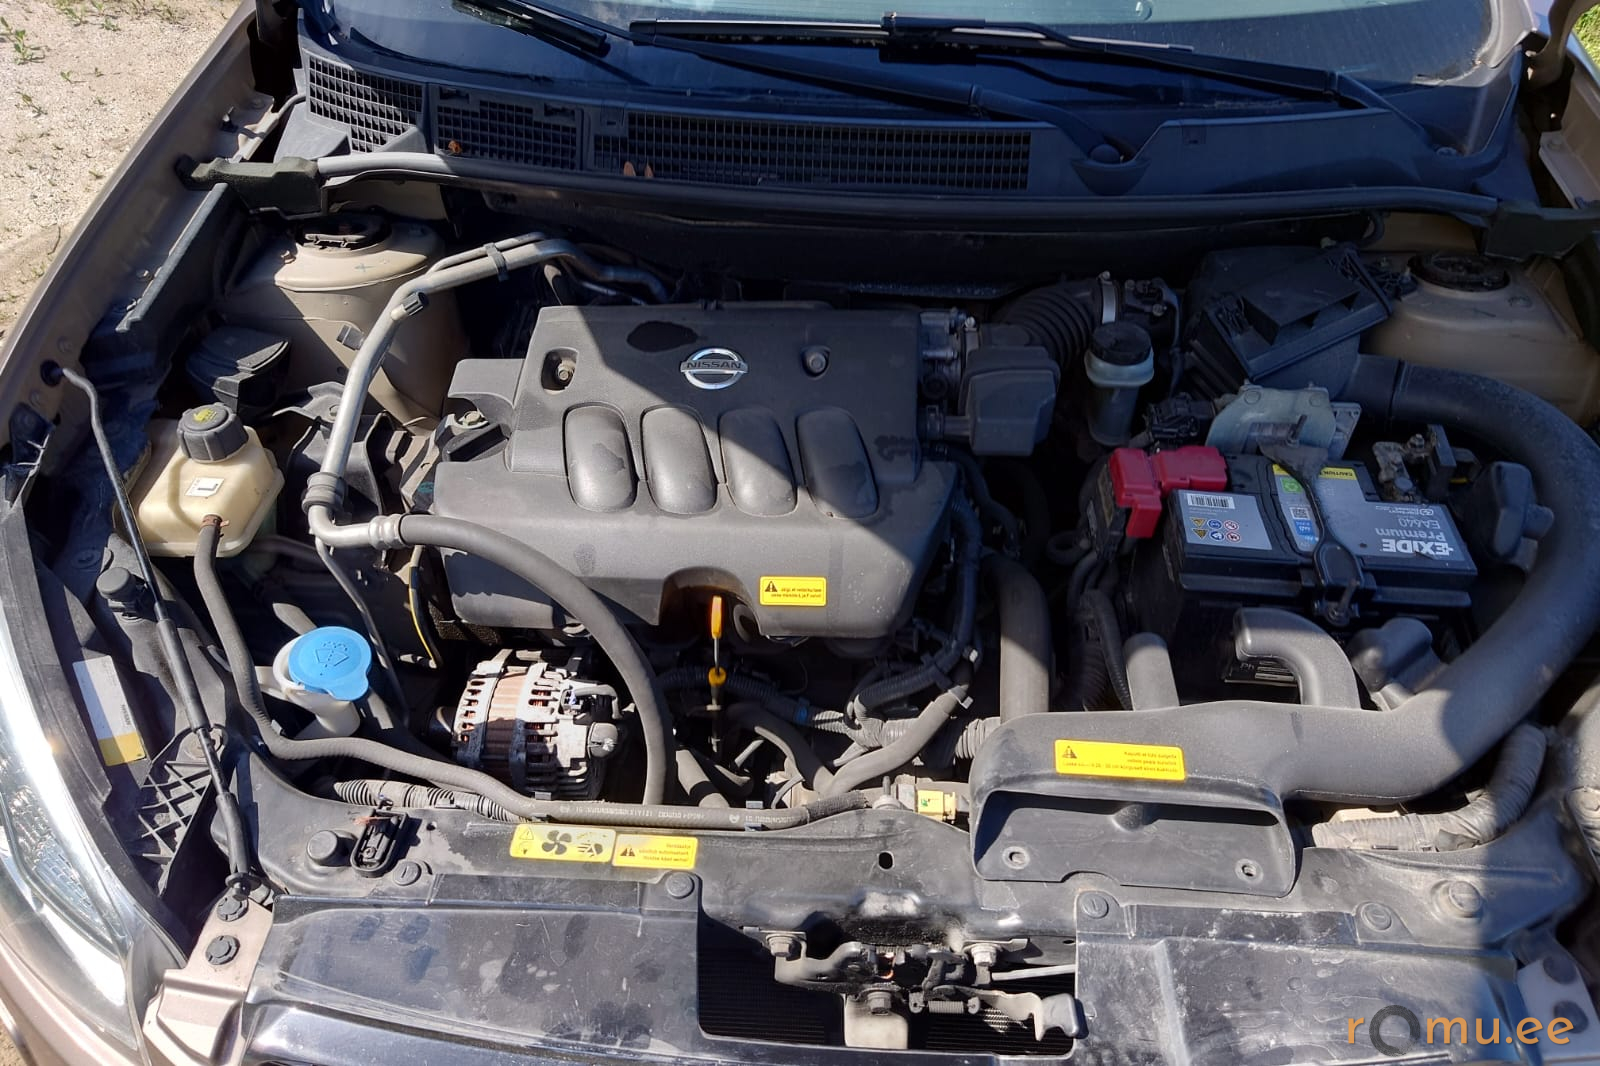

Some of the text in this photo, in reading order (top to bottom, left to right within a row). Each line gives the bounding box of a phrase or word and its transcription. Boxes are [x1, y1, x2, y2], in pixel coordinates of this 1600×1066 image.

[687, 361, 741, 369] NISSAN
[1374, 527, 1447, 542] Premium
[1381, 538, 1454, 556] EXIDE
